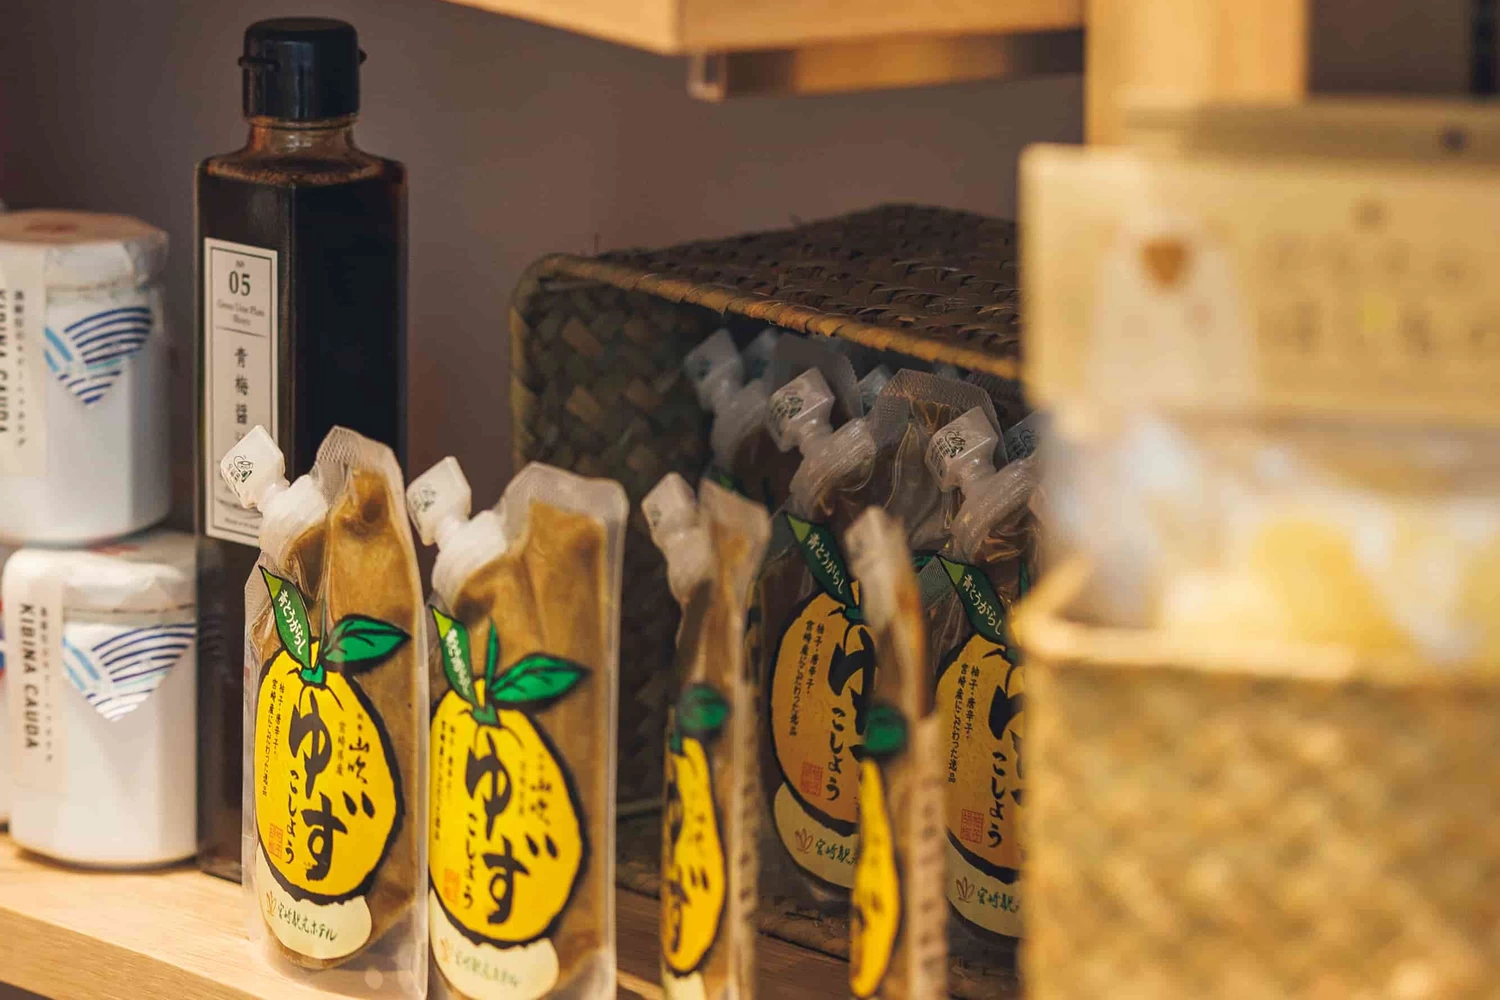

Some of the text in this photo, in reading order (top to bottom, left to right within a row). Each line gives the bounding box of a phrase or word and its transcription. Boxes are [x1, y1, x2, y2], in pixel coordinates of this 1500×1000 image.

[228, 270, 251, 297] 05
[806, 532, 846, 595] 青とうがらし
[962, 574, 1002, 637] 青とうがらし
[278, 589, 306, 655] 青とうがらし
[19, 603, 40, 750] KIBINA CAUDA
[288, 689, 376, 882] ゆず
[826, 706, 846, 802] こしょう
[987, 751, 1008, 849] こしょう
[284, 769, 300, 865] こしょう
[465, 731, 558, 925] ゆず
